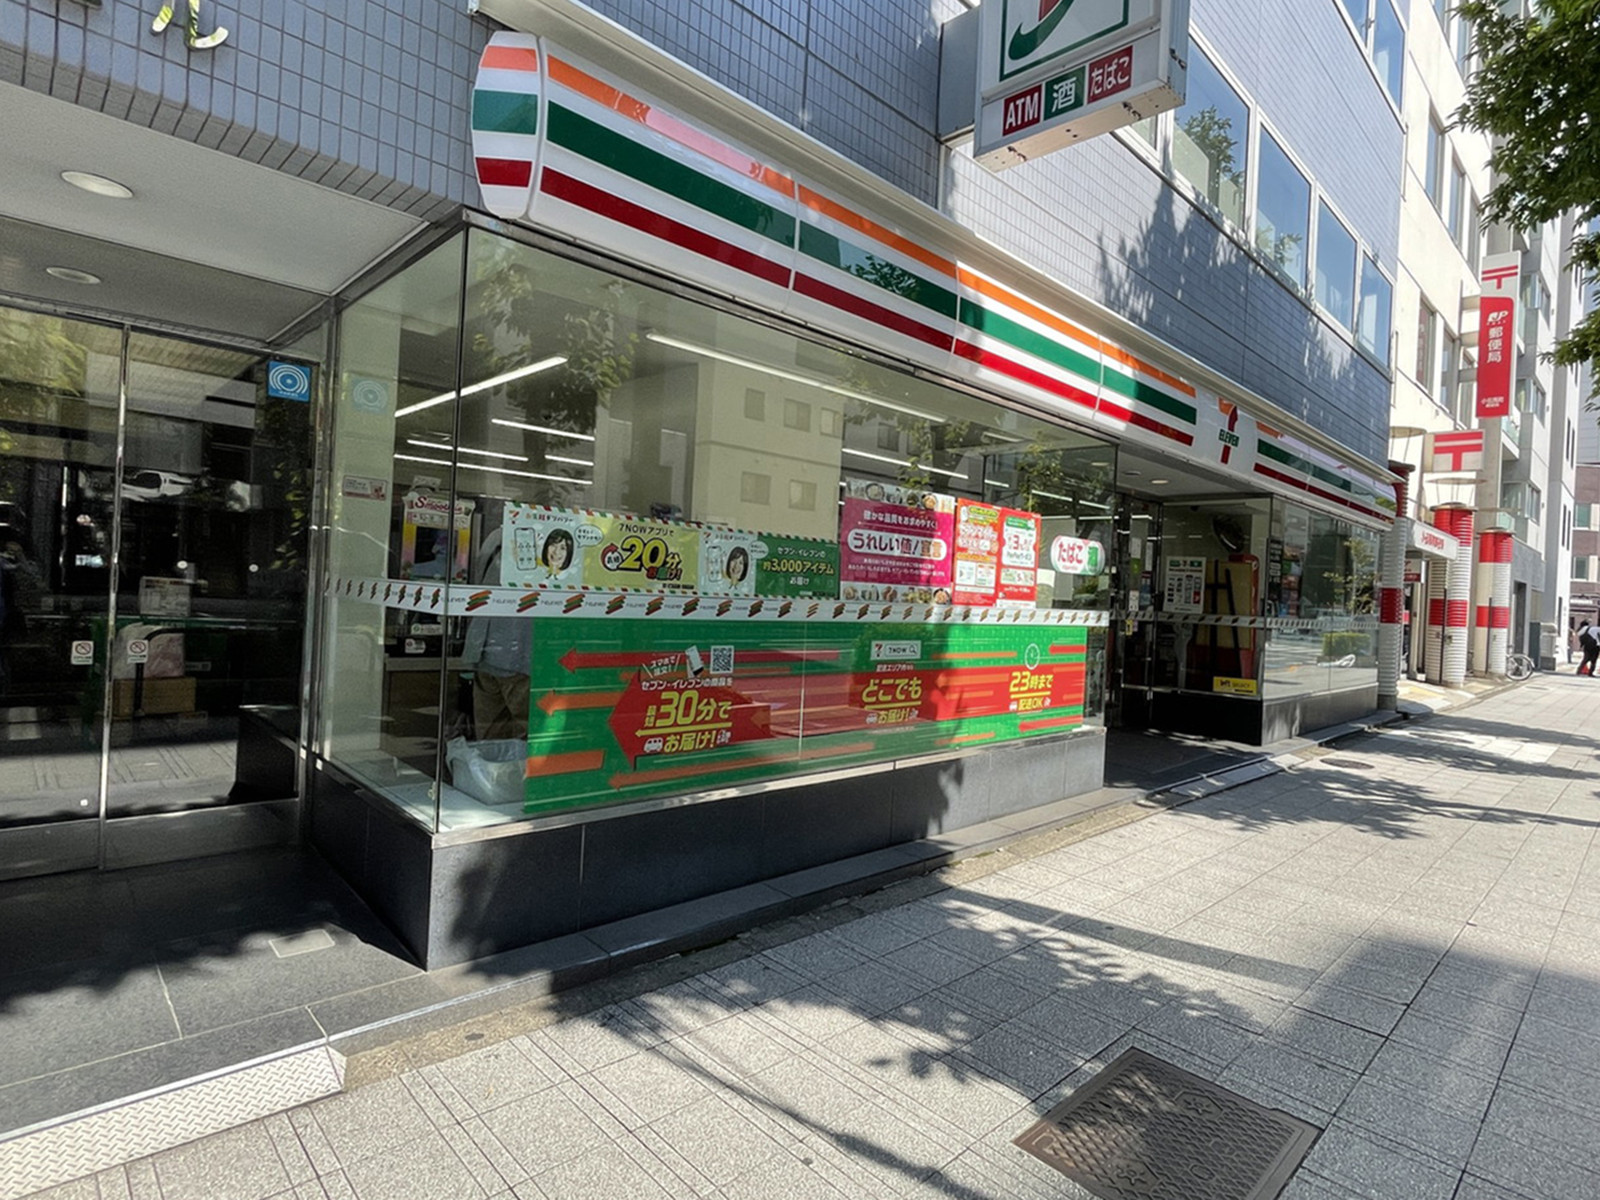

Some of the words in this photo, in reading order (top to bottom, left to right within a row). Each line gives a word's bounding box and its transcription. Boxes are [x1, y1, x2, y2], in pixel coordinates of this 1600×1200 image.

[1005, 91, 1039, 130] ATM
[1052, 77, 1077, 113] 酒
[1090, 56, 1130, 96] たばこ
[1486, 326, 1504, 363] 郵便局
[1057, 541, 1084, 564] たばこ
[763, 558, 835, 575] 約3,000アイテム
[650, 655, 676, 669] スマホで
[862, 676, 922, 703] どこでも
[1009, 671, 1054, 692] 23時まで
[878, 707, 910, 724] お届け!
[664, 729, 717, 753] お届け!
